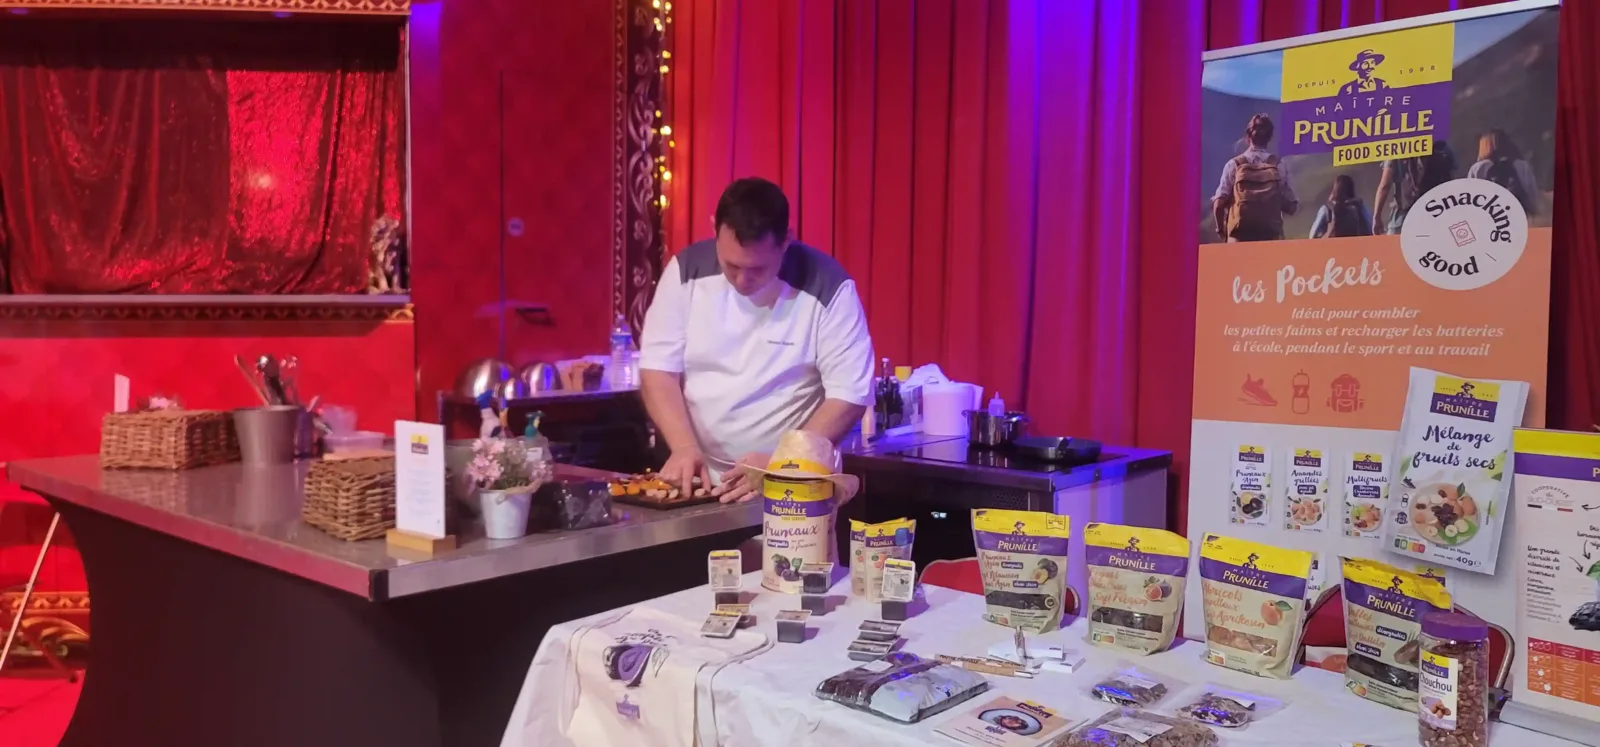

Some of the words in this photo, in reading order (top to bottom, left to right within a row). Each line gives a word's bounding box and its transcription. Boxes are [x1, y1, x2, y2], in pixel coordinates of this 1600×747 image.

[1297, 78, 1336, 89] DEPUIS
[1338, 146, 1370, 162] FOOD
[1375, 139, 1428, 158] SERVICE
[1425, 192, 1512, 243] Snacking
[1418, 251, 1480, 277] good
[1232, 275, 1268, 304] les
[1276, 257, 1386, 304] Pockets
[1291, 308, 1326, 320] Idéal
[1327, 309, 1359, 322] pour
[1362, 306, 1421, 319] combler
[1223, 324, 1240, 337] les
[1241, 324, 1283, 338] petites
[1284, 324, 1322, 339] faims
[1325, 325, 1338, 337] et
[1341, 325, 1409, 340] recharger
[1412, 324, 1433, 338] les
[1436, 324, 1505, 338] batteries
[1243, 341, 1284, 355] l'école,
[1284, 341, 1340, 356] pendant
[1343, 341, 1355, 354] le
[1358, 343, 1393, 357] sport
[1397, 344, 1412, 355] et
[1414, 346, 1434, 356] au
[1438, 343, 1491, 357] travail
[1422, 425, 1495, 449] Mélange
[1446, 441, 1462, 451] de
[1412, 451, 1460, 468] fruits
[1465, 457, 1498, 470] secs
[765, 520, 819, 538] Pruneaux
[1456, 556, 1474, 567] 40g
